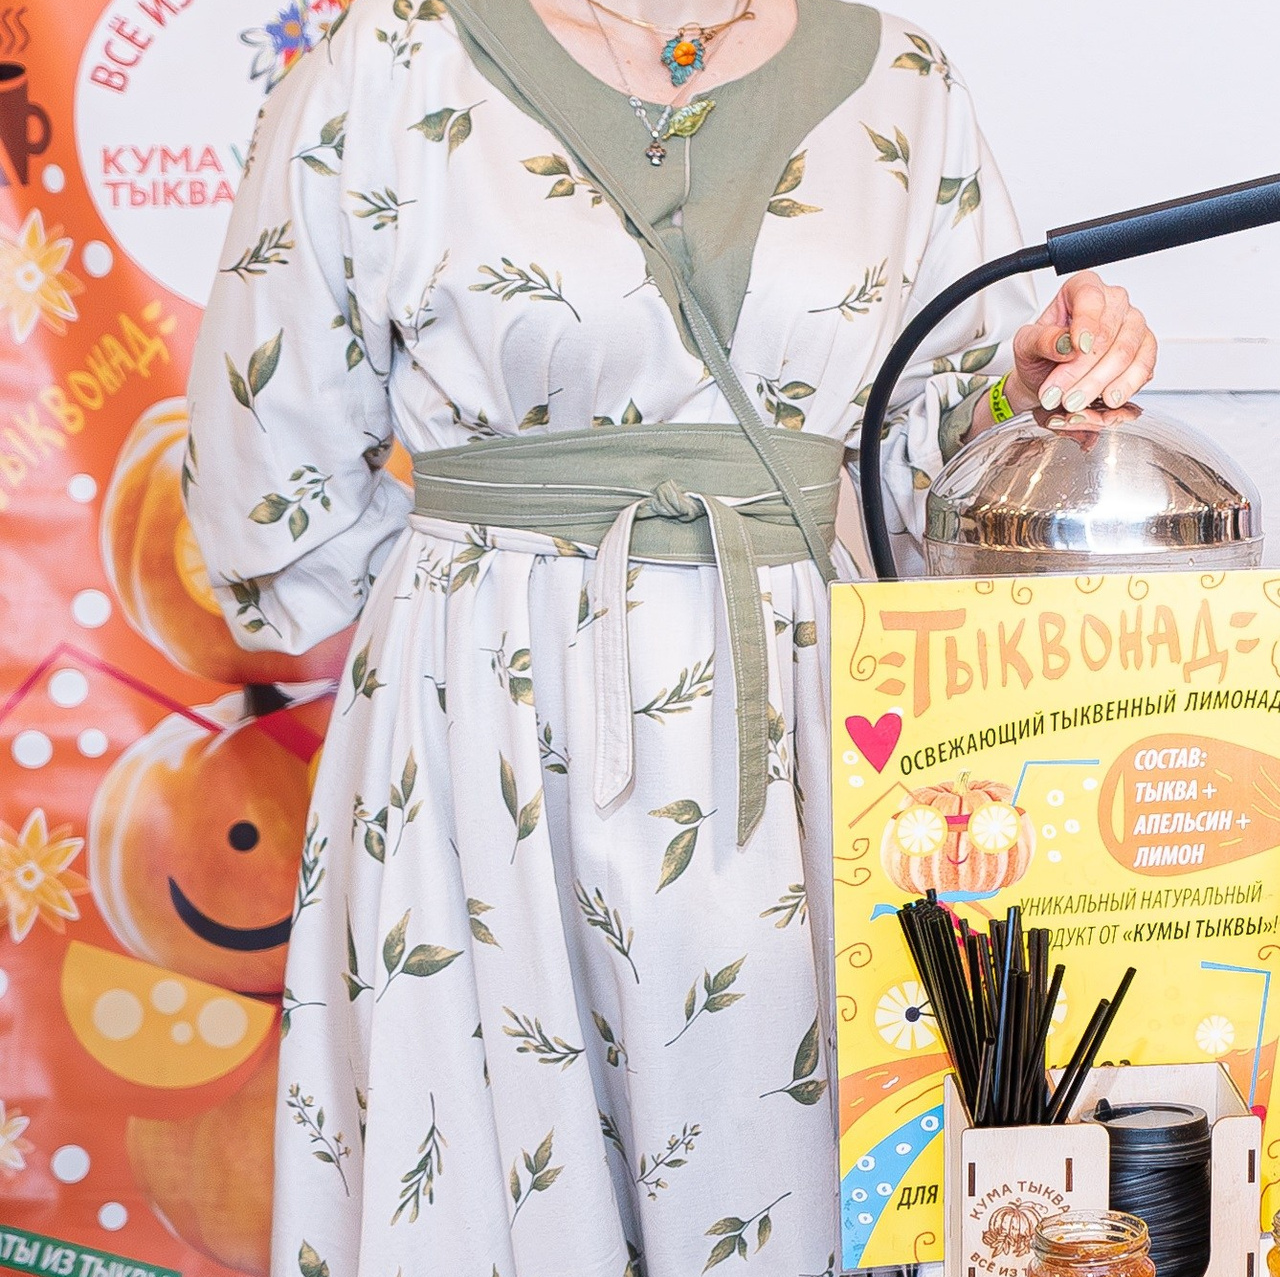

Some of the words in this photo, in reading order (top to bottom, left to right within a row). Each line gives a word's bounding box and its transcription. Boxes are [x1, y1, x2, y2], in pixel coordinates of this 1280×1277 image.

[89, 8, 154, 94] ВСЁ
[103, 145, 222, 174] КУМА
[103, 182, 234, 207] ТЫКВА
[879, 599, 1230, 717] ТЫКВОНАД
[900, 710, 1045, 776] ОСВЕЖАЮЩИЙ
[1049, 688, 1177, 733] ТЫКВЕННЫЙ
[1134, 748, 1208, 771] СОСТАВ:
[1135, 780, 1198, 803] ТЫКВА
[1132, 813, 1233, 836] АПЕЛЬСИН
[1132, 843, 1205, 868] ЛИМОН
[1019, 888, 1138, 917] УНИКАЛЬНЫЙ
[1140, 880, 1263, 910] НАТУРАЛЬНЫЙ
[1099, 925, 1121, 943] ОТ
[1123, 921, 1191, 943] «КУМЫ
[897, 1184, 940, 1210] ДЛЯ
[970, 1183, 1013, 1220] КУМА
[1017, 1181, 1071, 1213] ТЫКВА
[40, 1244, 77, 1276] ИЗ
[970, 1252, 996, 1273] ВСЁ
[998, 1266, 1018, 1277] ИЗ
